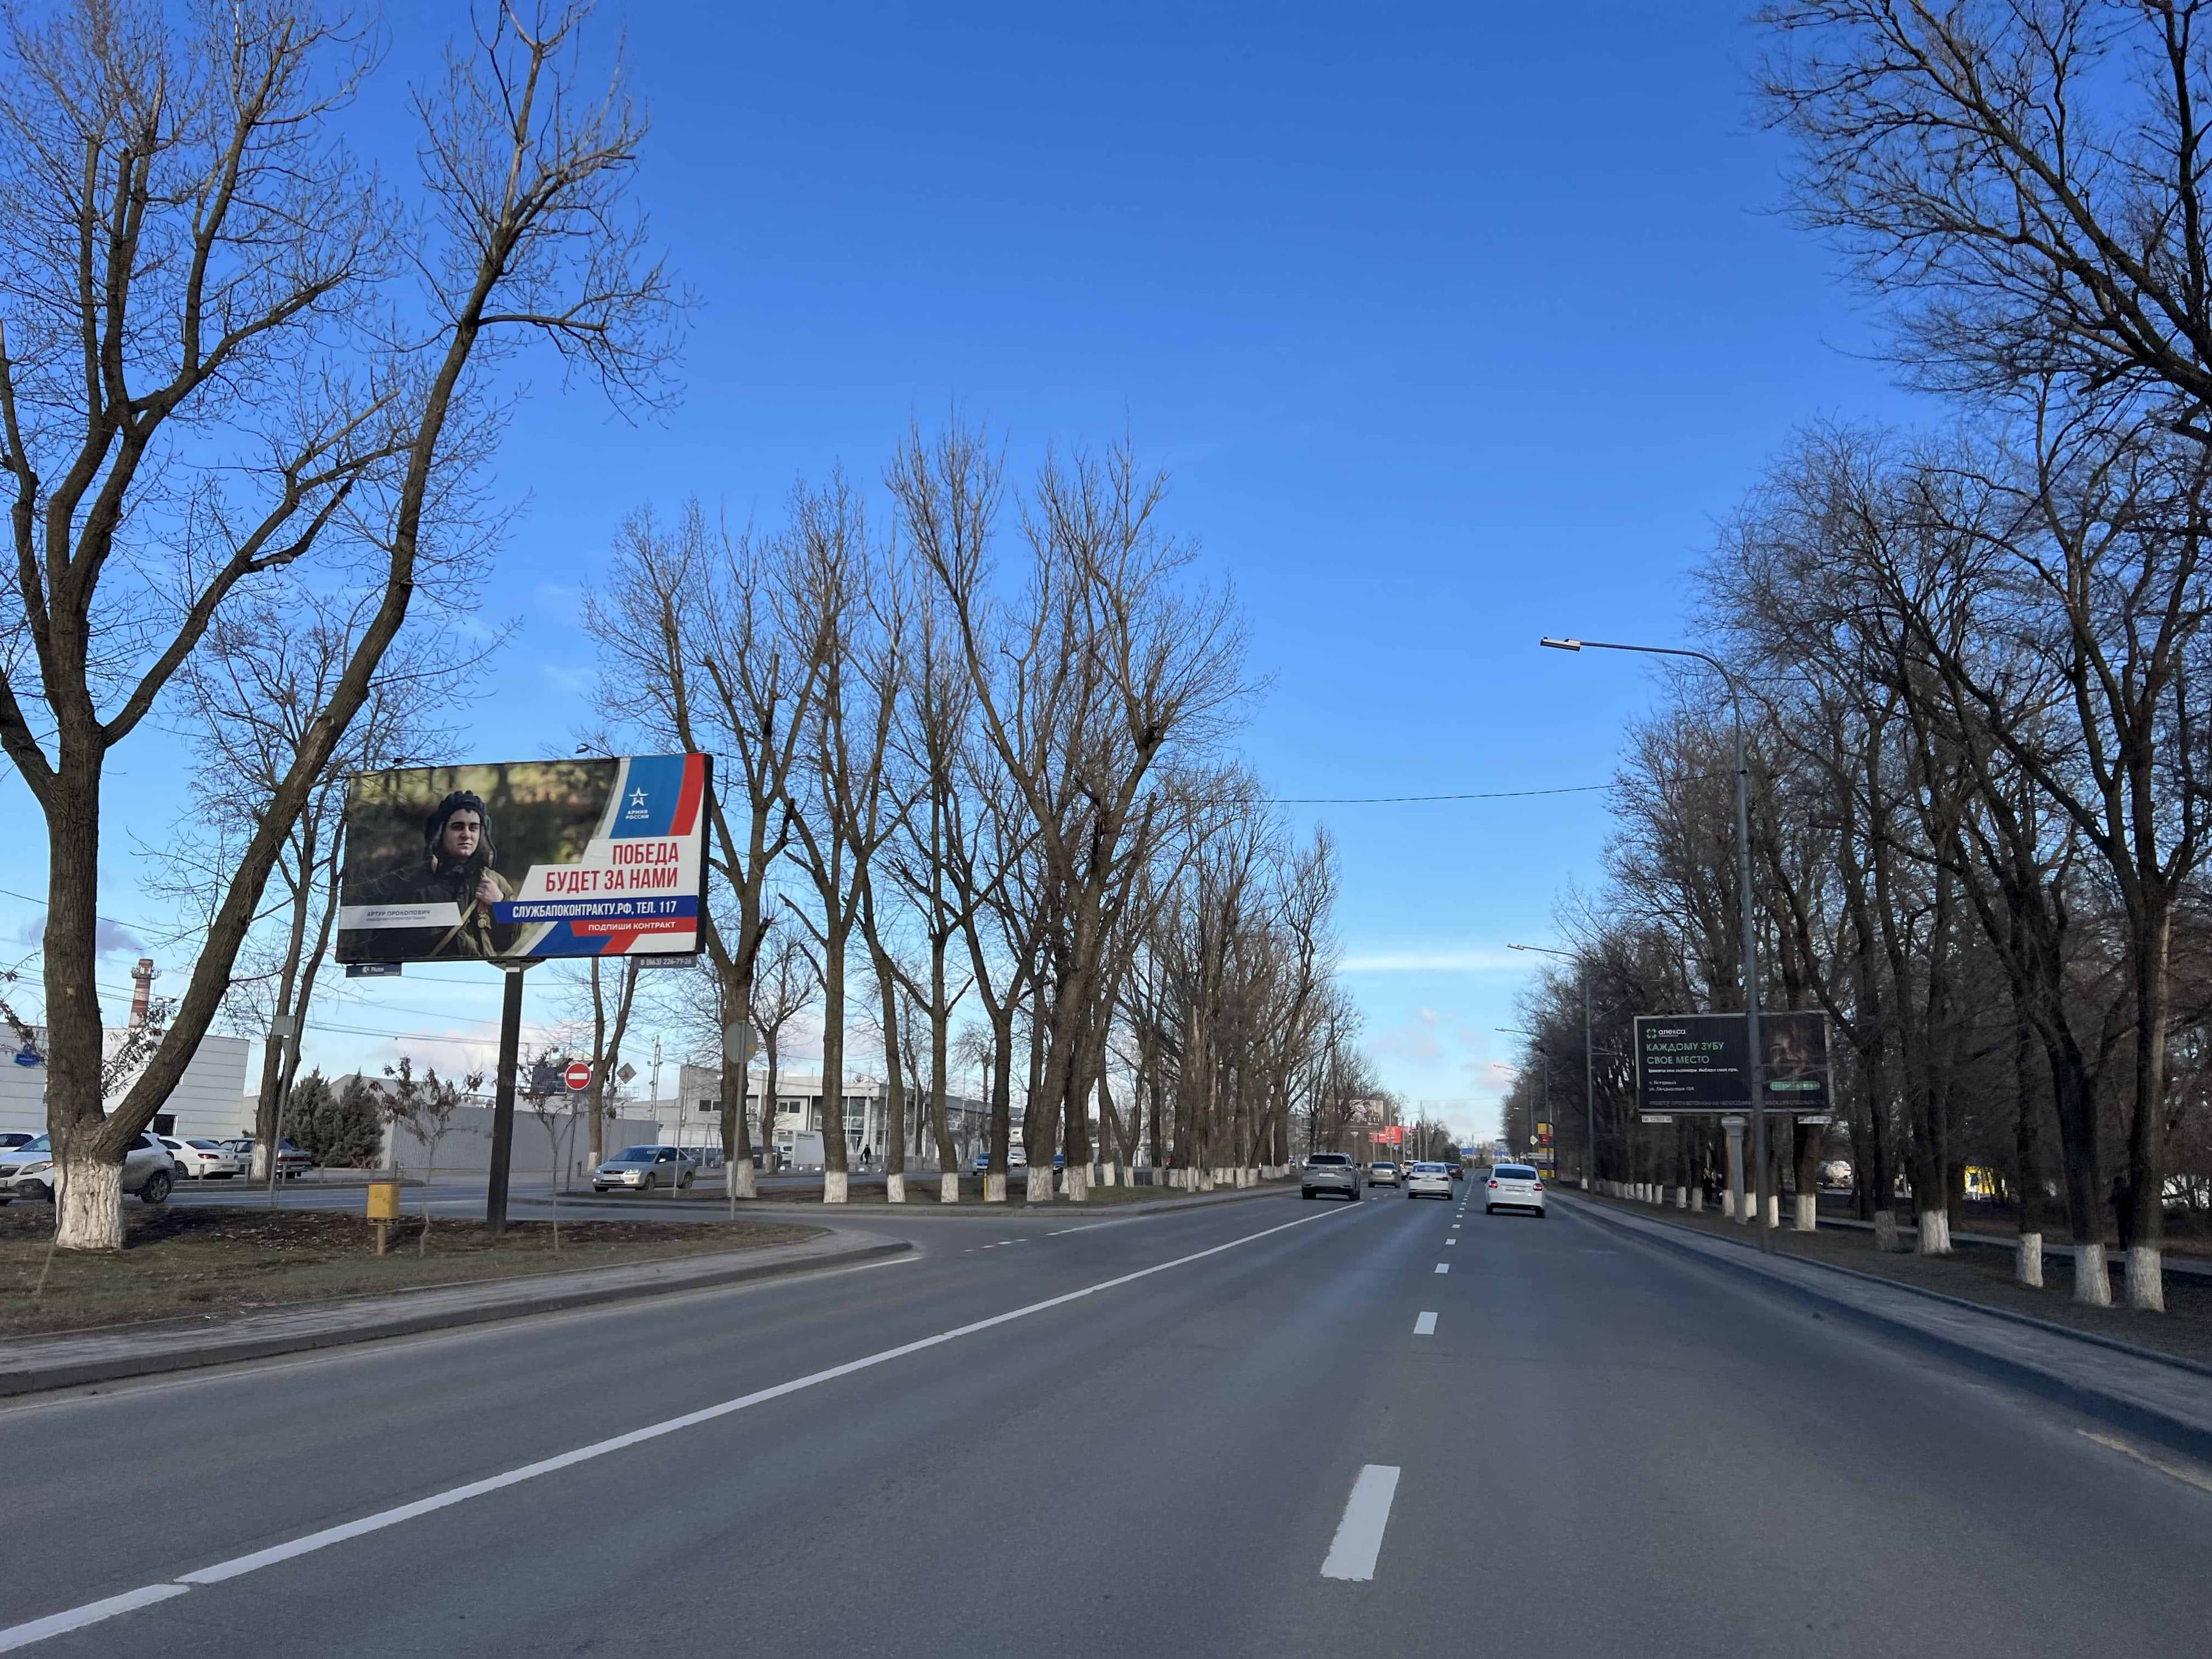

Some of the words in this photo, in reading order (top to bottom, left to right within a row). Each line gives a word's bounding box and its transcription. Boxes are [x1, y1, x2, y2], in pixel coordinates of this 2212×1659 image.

[612, 843, 679, 865] ПОБЕДА
[546, 870, 600, 893] БУДЕТ
[604, 869, 624, 890] ЗА
[630, 868, 678, 889] НАМИ
[512, 903, 634, 918] СЛУЖБАПОКОНТРАКТУ.РФ,
[636, 902, 656, 914] ТЕЛ.
[660, 901, 677, 913] 117
[588, 923, 632, 931] ПОДПИШИ
[633, 921, 676, 929] КОНТРАКТ
[1646, 1043, 1698, 1052] КАЖДОМУ
[1701, 1042, 1724, 1050] ЗУБУ
[1647, 1056, 1673, 1065] СВОЕ
[1676, 1055, 1710, 1064] МЕСТО
